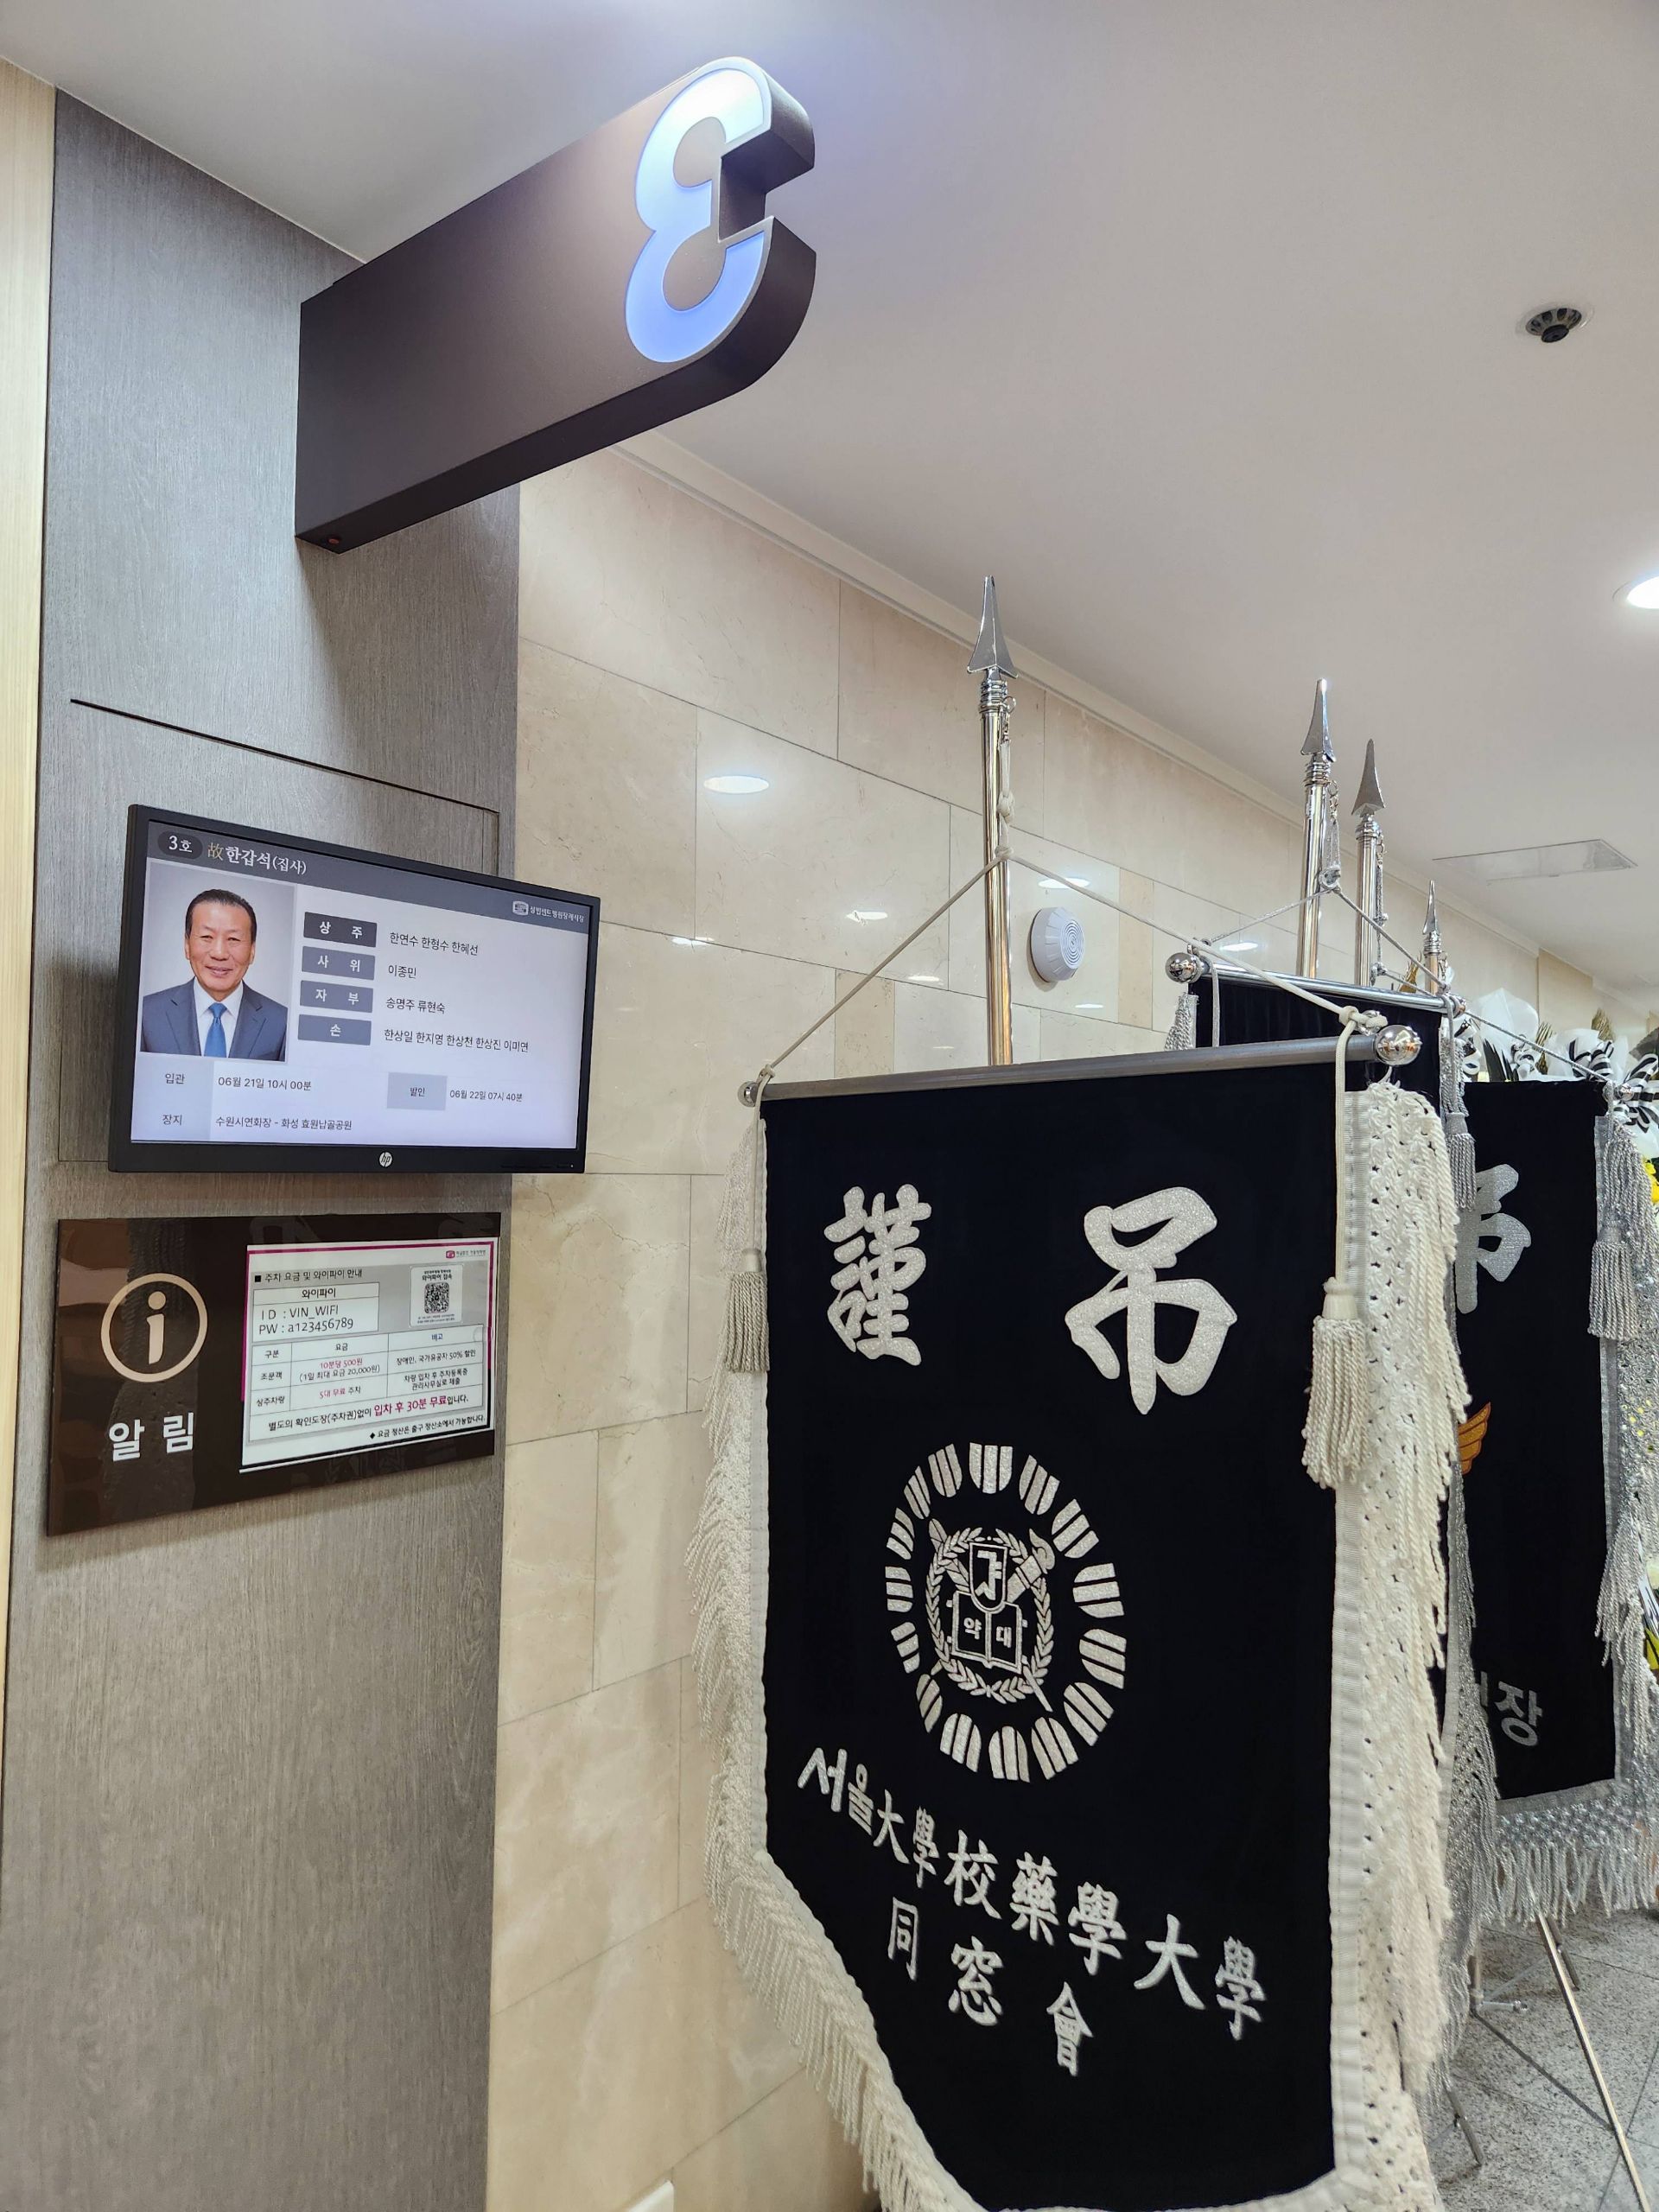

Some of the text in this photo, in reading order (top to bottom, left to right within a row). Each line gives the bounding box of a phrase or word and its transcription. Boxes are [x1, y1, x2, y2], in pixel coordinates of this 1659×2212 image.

[168, 835, 193, 853] 3호
[390, 932, 478, 957] 한연수 한형수 한혜선
[388, 964, 416, 979] 이종민
[386, 997, 446, 1014] 송명주 류현숙
[329, 1024, 341, 1037] 손
[385, 1029, 529, 1053] 한상일 한지영 한상천 한상진 이미연
[165, 1073, 185, 1085] 입관
[218, 1077, 312, 1091] 06월 21일 10시 00분
[410, 1087, 425, 1097] 발인
[449, 1090, 523, 1103] 06월 22일 07시 40분
[162, 1115, 182, 1126] 장지
[216, 1116, 271, 1128] 수원시연화장
[281, 1118, 299, 1129] 화성
[379, 1152, 392, 1166] hp
[265, 1268, 363, 1282] 주차 요금 및 와이파이 안내
[302, 1287, 336, 1299] 와이파이
[289, 1305, 339, 1319] VIN_WIFI
[259, 1324, 277, 1334] PW
[288, 1318, 353, 1332] a123456789
[334, 1343, 348, 1351] 요금
[264, 1350, 279, 1359] 구분
[449, 1351, 463, 1360] 50%
[343, 1357, 363, 1367] 500원
[261, 1371, 283, 1381] 조문객
[299, 1371, 315, 1382] (1일
[317, 1370, 330, 1379] 최대
[333, 1369, 346, 1377] 요금
[319, 1386, 361, 1399] 5대 무료 주차
[374, 1403, 392, 1416] 입차
[395, 1402, 404, 1413] 후
[407, 1398, 427, 1412] 30분
